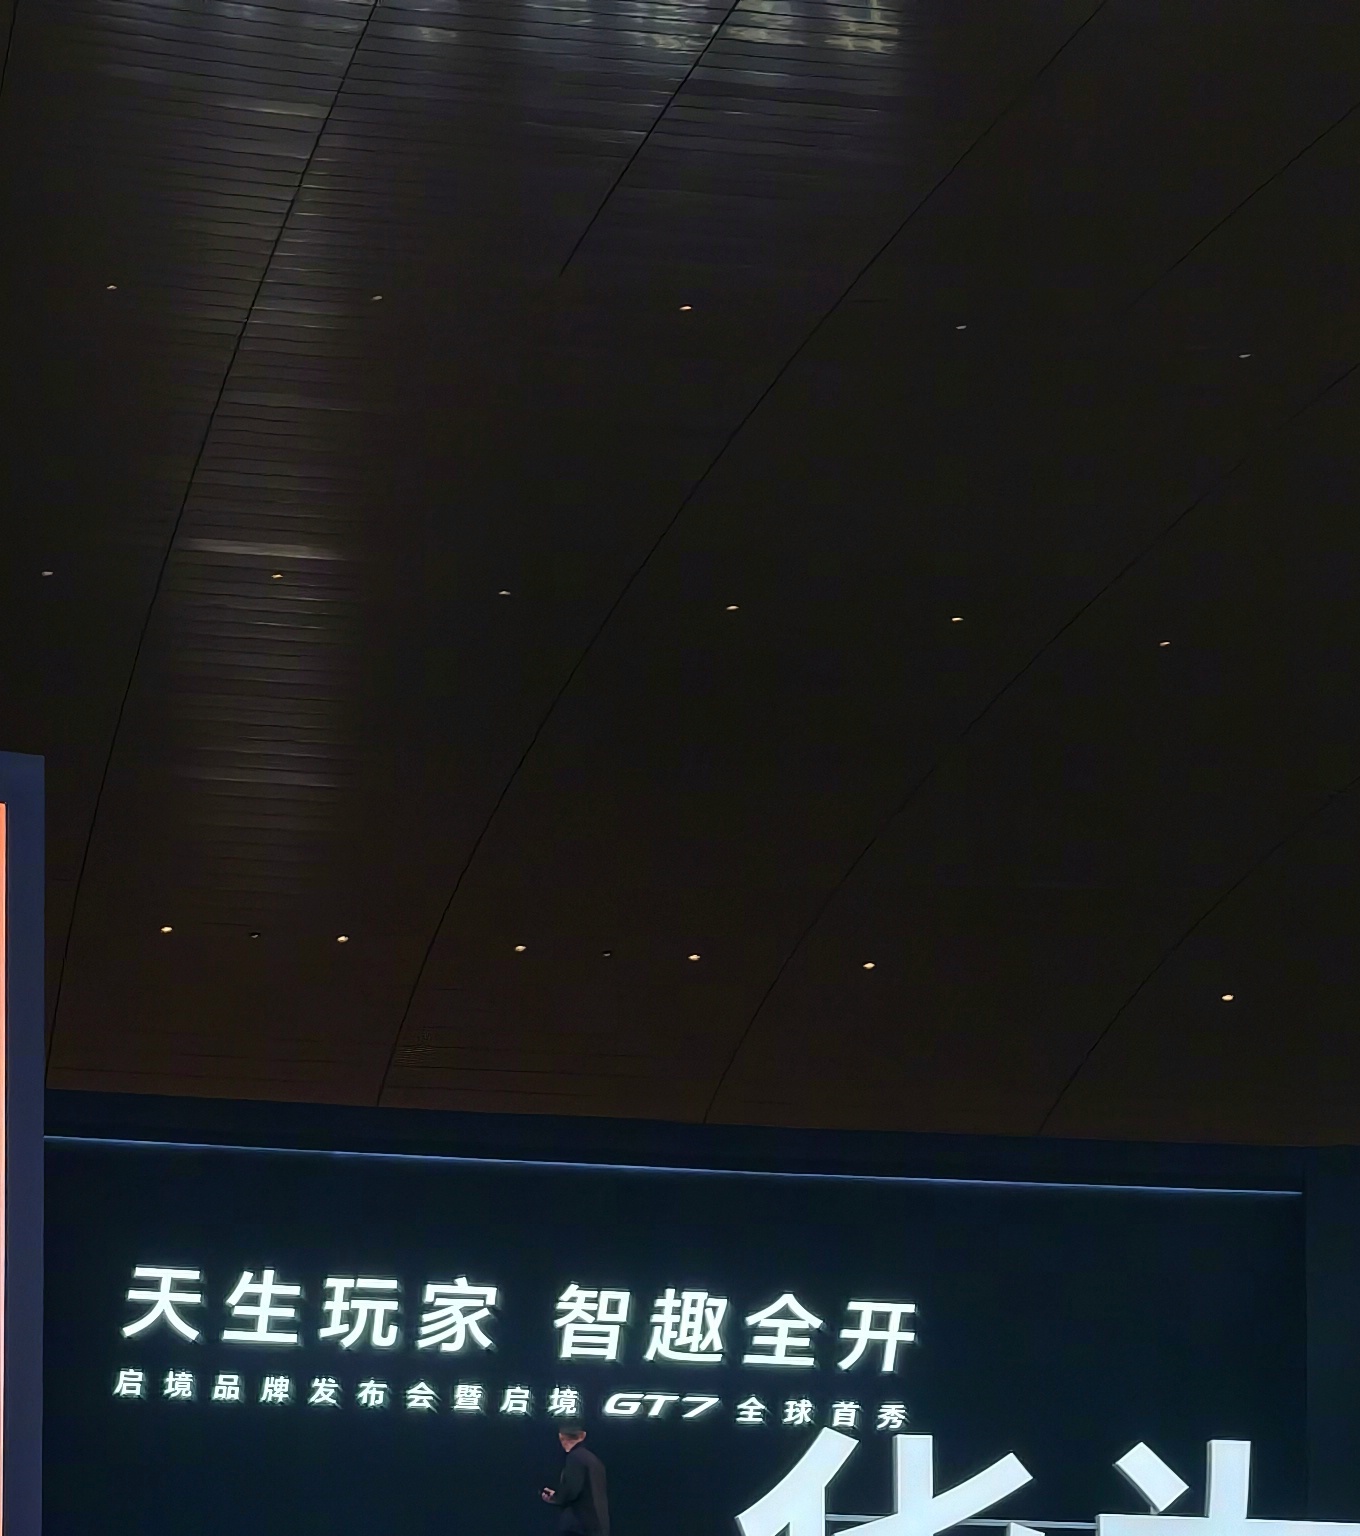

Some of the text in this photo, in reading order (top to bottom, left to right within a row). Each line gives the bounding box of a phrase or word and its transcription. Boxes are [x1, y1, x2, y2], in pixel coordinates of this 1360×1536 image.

[122, 1266, 917, 1372] 天生玩家 智趣全开
[113, 1368, 908, 1431] 启境品牌发布会暨启境 GT7 全球首秀
